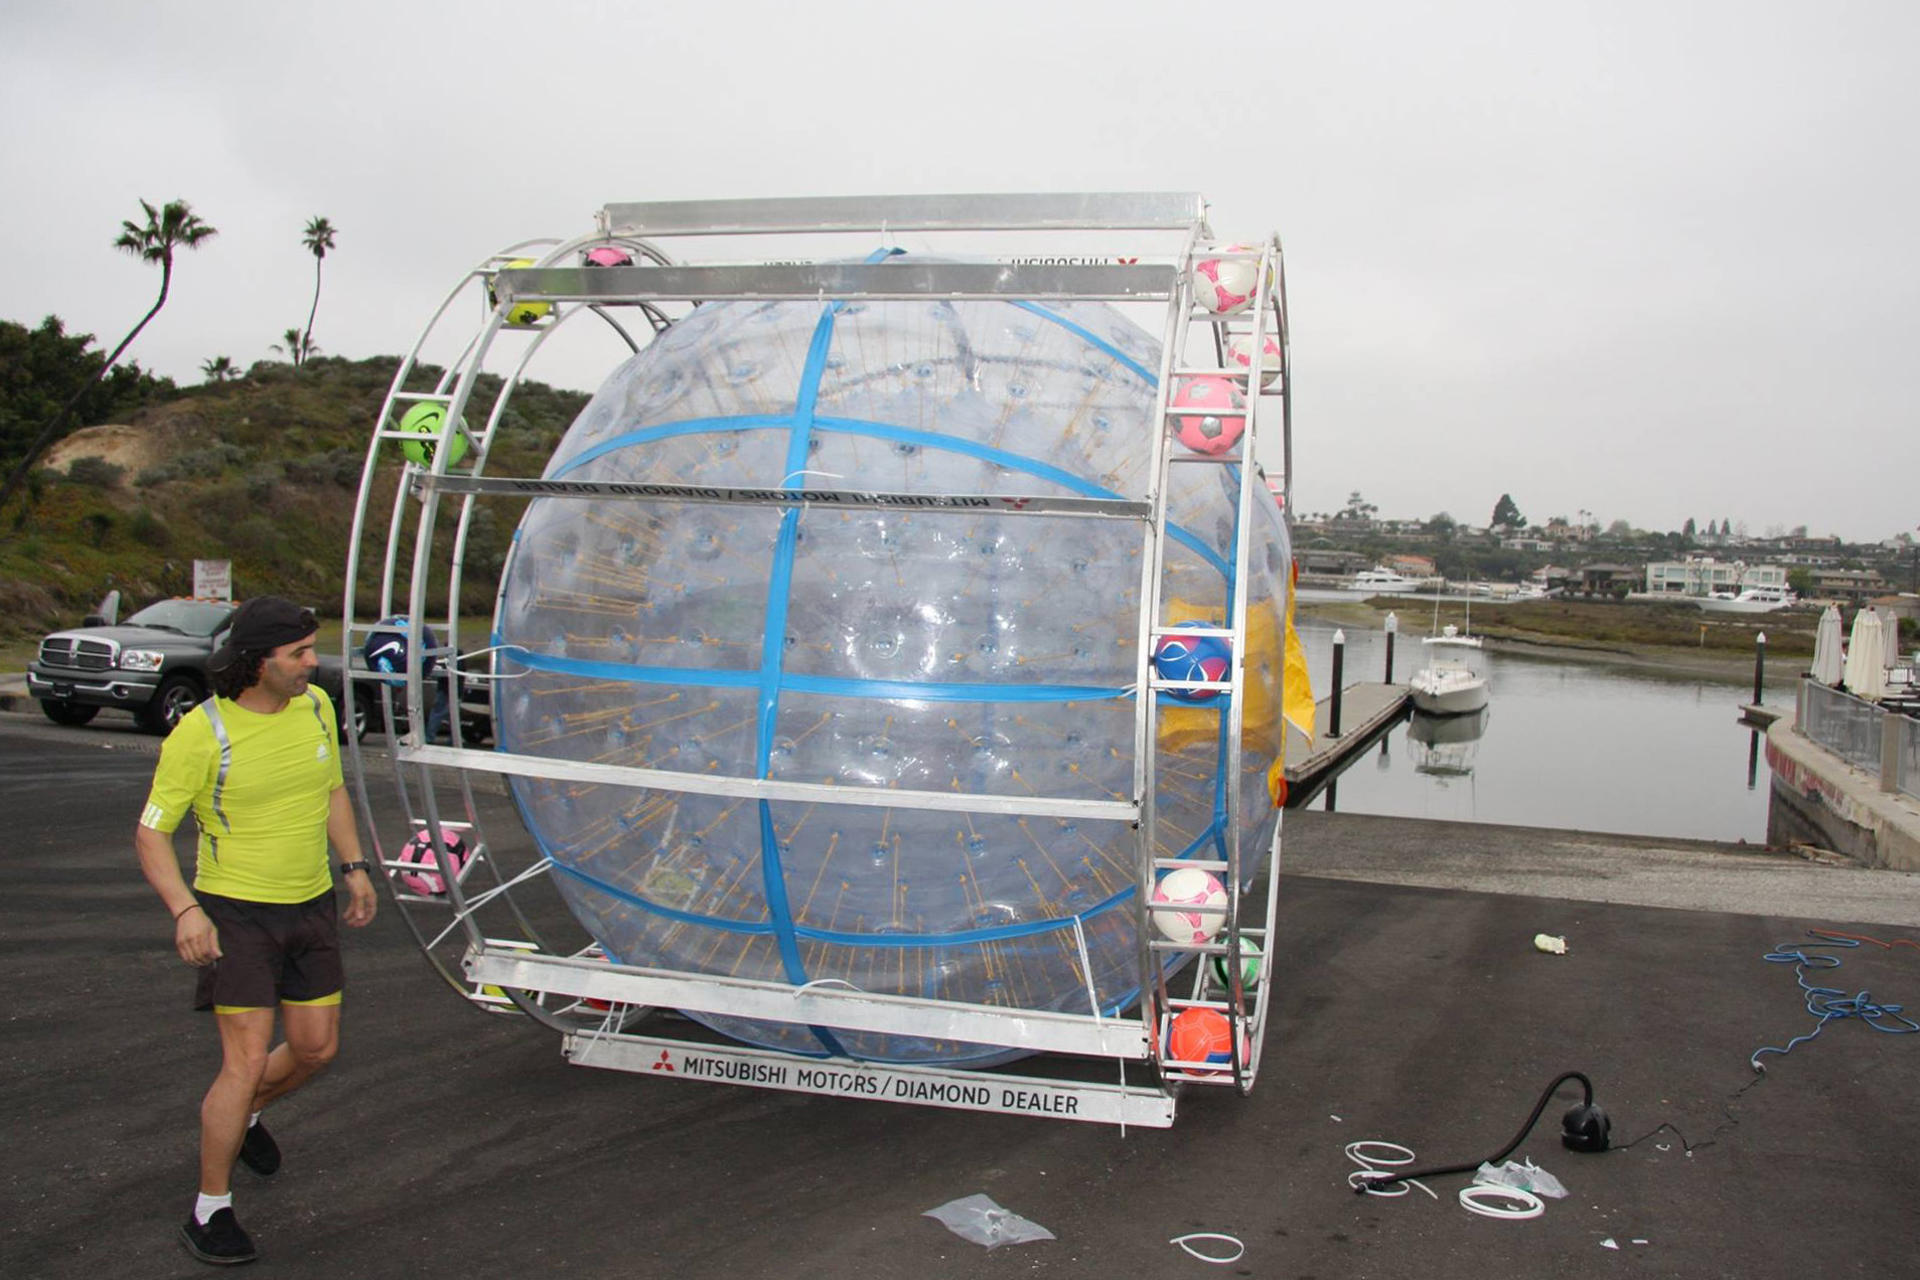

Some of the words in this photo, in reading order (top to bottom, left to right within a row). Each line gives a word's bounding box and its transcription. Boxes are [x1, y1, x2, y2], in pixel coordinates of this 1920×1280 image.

[513, 481, 600, 493] DEALER
[609, 484, 720, 499] DIAMOND
[740, 489, 841, 502] MOTORS
[684, 1057, 786, 1084] MITSUBISHI
[797, 1069, 877, 1094] MOTORS
[896, 1079, 990, 1106] DIAMOND
[1002, 1090, 1078, 1114] DEALER
